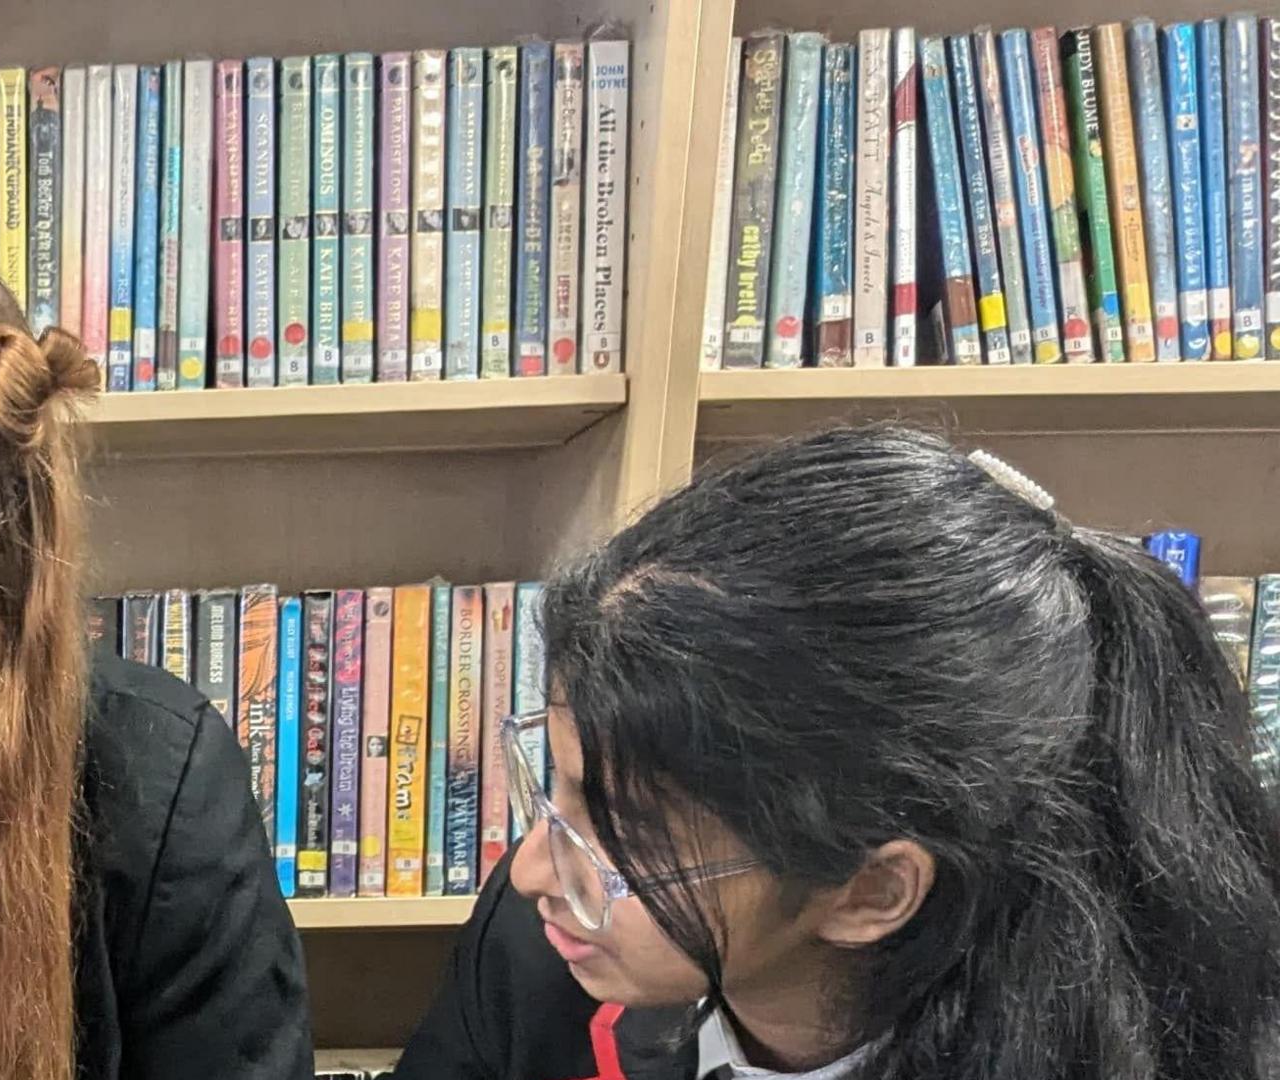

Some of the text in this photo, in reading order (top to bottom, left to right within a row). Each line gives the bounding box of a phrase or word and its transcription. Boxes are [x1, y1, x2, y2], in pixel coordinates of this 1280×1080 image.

[593, 65, 625, 76] JOHN
[1076, 32, 1100, 134] JUDY BLUME
[255, 112, 269, 300] SCANDAL KATE
[319, 107, 335, 296] OMINOUS KATE
[389, 96, 402, 294] PARADISE LOST KATE
[593, 105, 617, 332] All the Broken Places
[37, 152, 53, 298] Tom Becker DARKSIDE
[352, 246, 366, 293] KATE
[736, 224, 761, 313] cathy brett
[491, 335, 500, 347] B
[600, 337, 608, 349] B
[864, 333, 874, 345] B
[1244, 315, 1252, 327] B
[290, 361, 299, 373] B
[324, 350, 333, 361] B
[424, 355, 433, 367] B
[209, 638, 225, 685] BURGESS
[456, 608, 473, 760] BORDER CROSSING
[494, 649, 507, 689] HOPE
[249, 703, 271, 738] ink
[339, 686, 358, 792] Living the Dream
